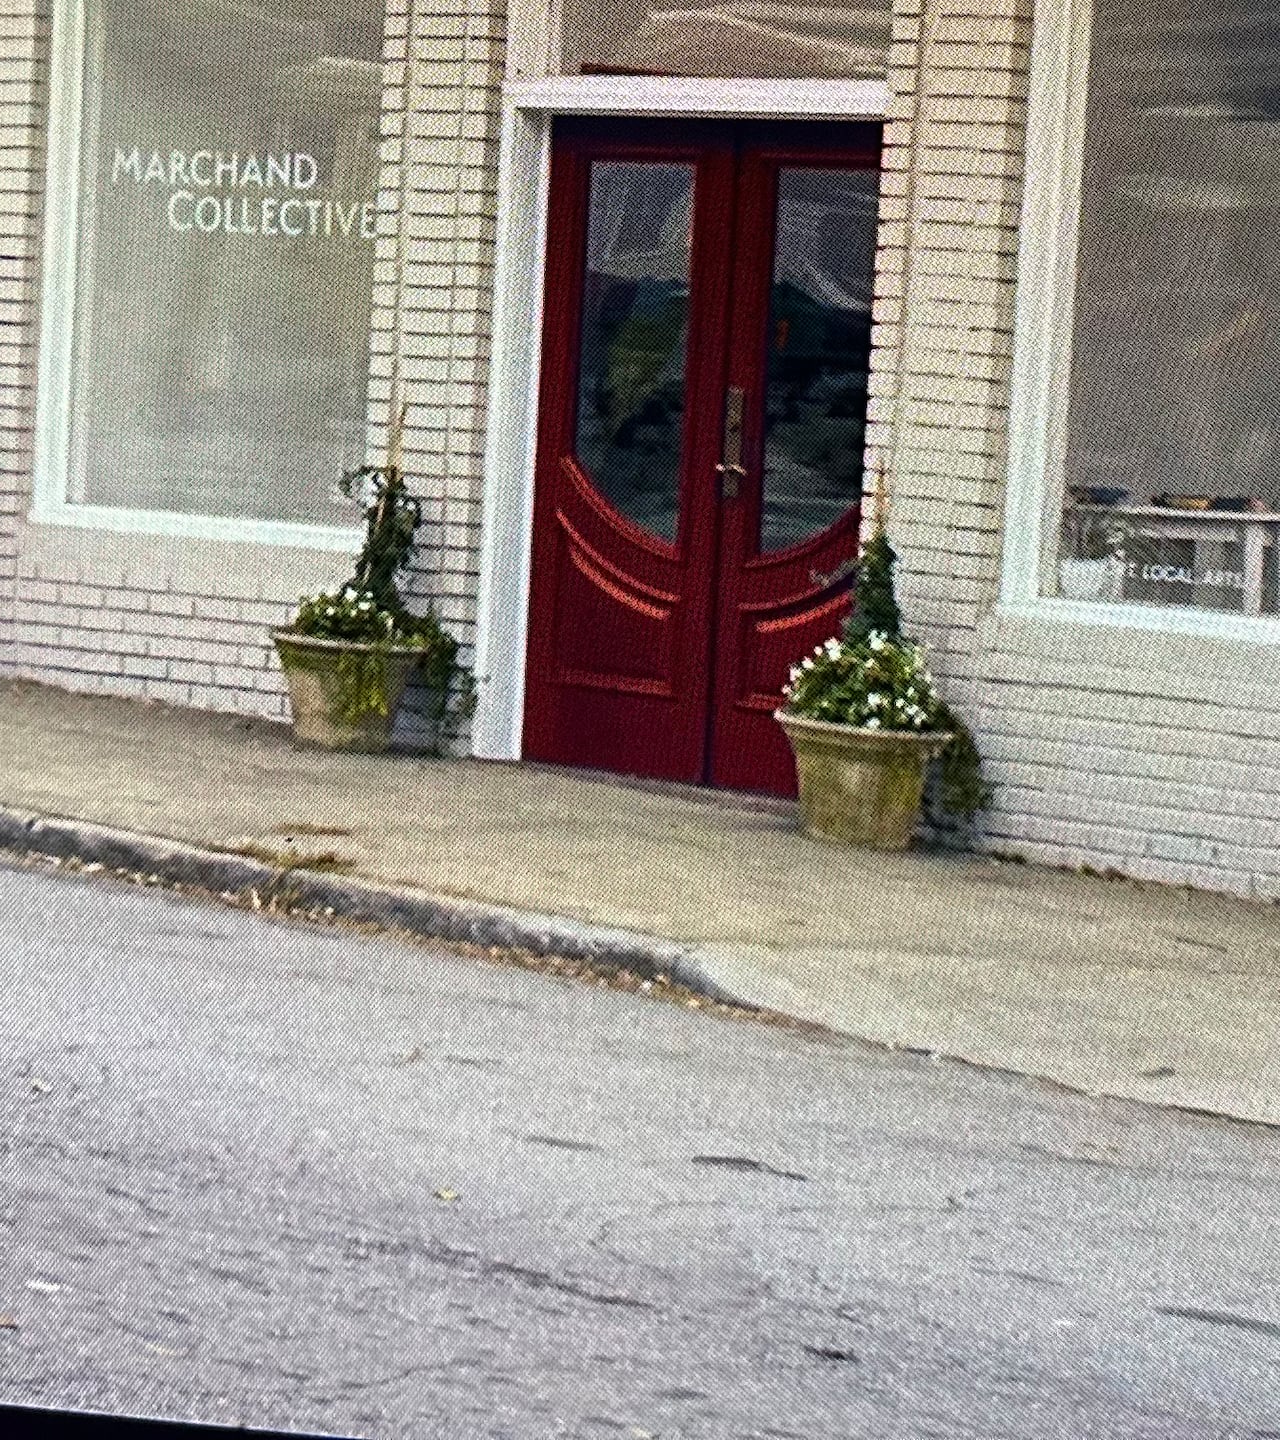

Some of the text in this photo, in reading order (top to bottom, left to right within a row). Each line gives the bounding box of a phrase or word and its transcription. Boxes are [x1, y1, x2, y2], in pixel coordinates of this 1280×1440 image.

[110, 147, 319, 190] MARCHAND
[167, 189, 378, 239] COLLECTIVE
[1141, 562, 1196, 585] LOCAL
